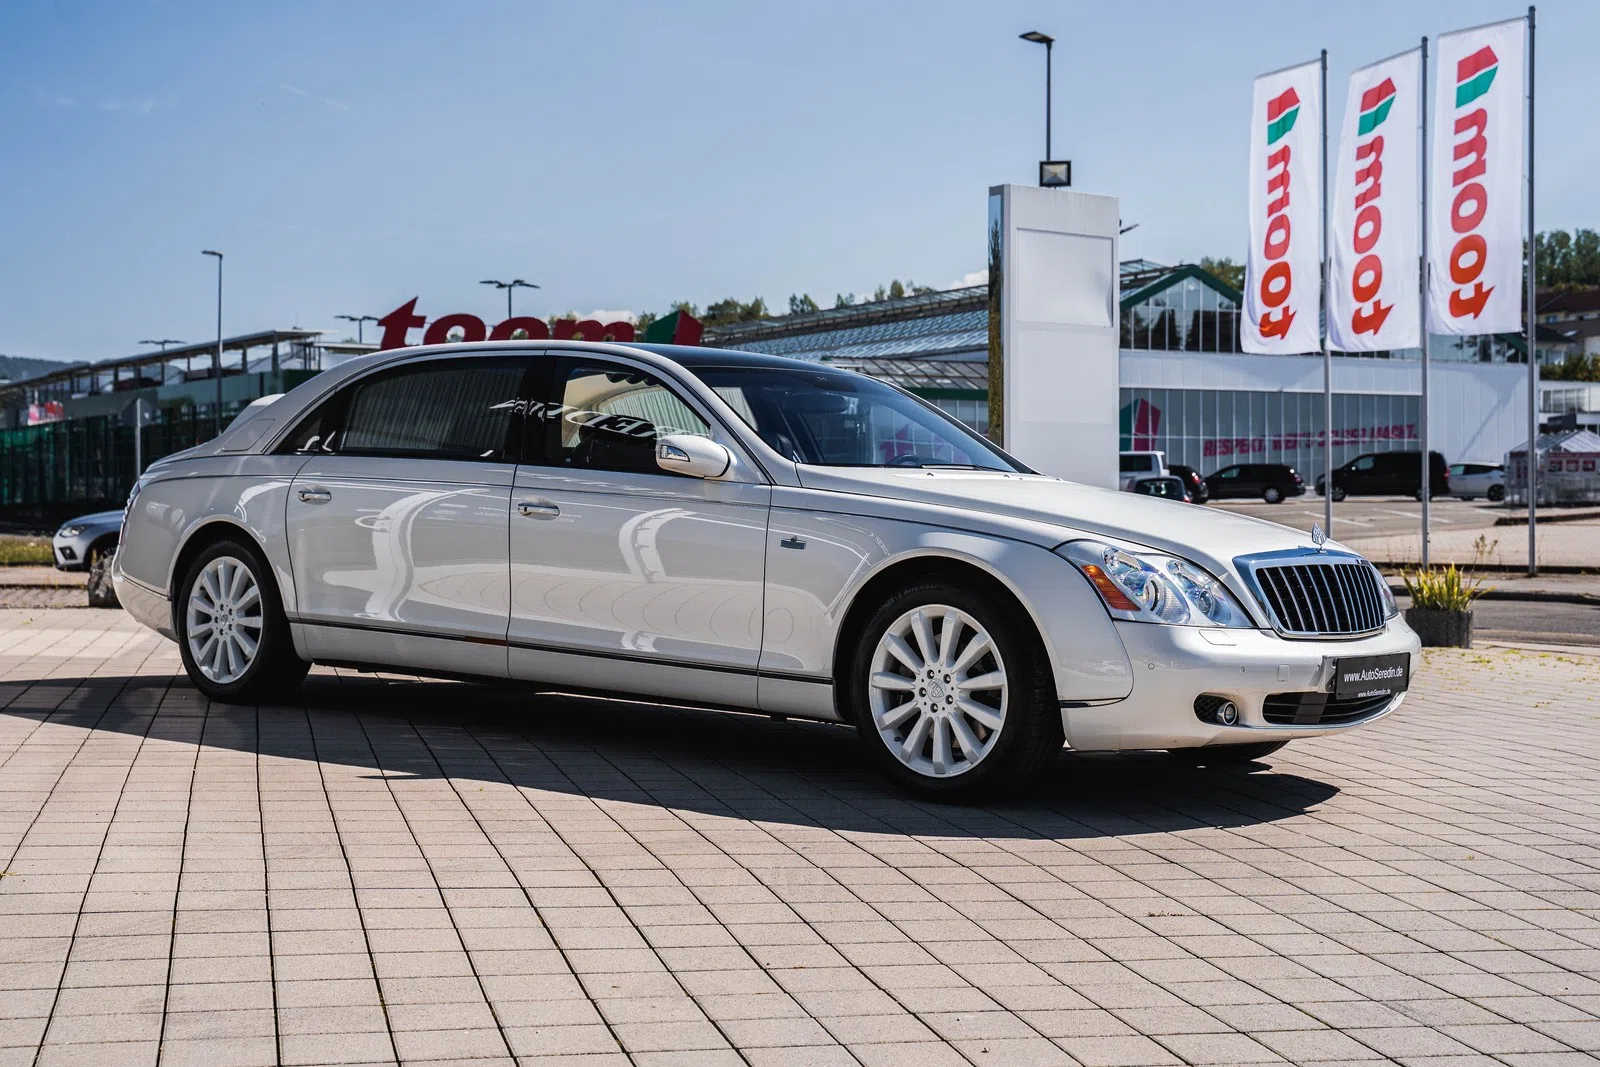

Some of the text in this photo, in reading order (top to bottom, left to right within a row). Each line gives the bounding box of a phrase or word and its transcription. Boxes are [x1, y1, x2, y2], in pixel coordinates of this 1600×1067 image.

[1259, 145, 1297, 340] toom
[1351, 135, 1394, 335] toom
[1449, 108, 1495, 319] toom
[1344, 666, 1403, 683] www.AutoSeredin.de
